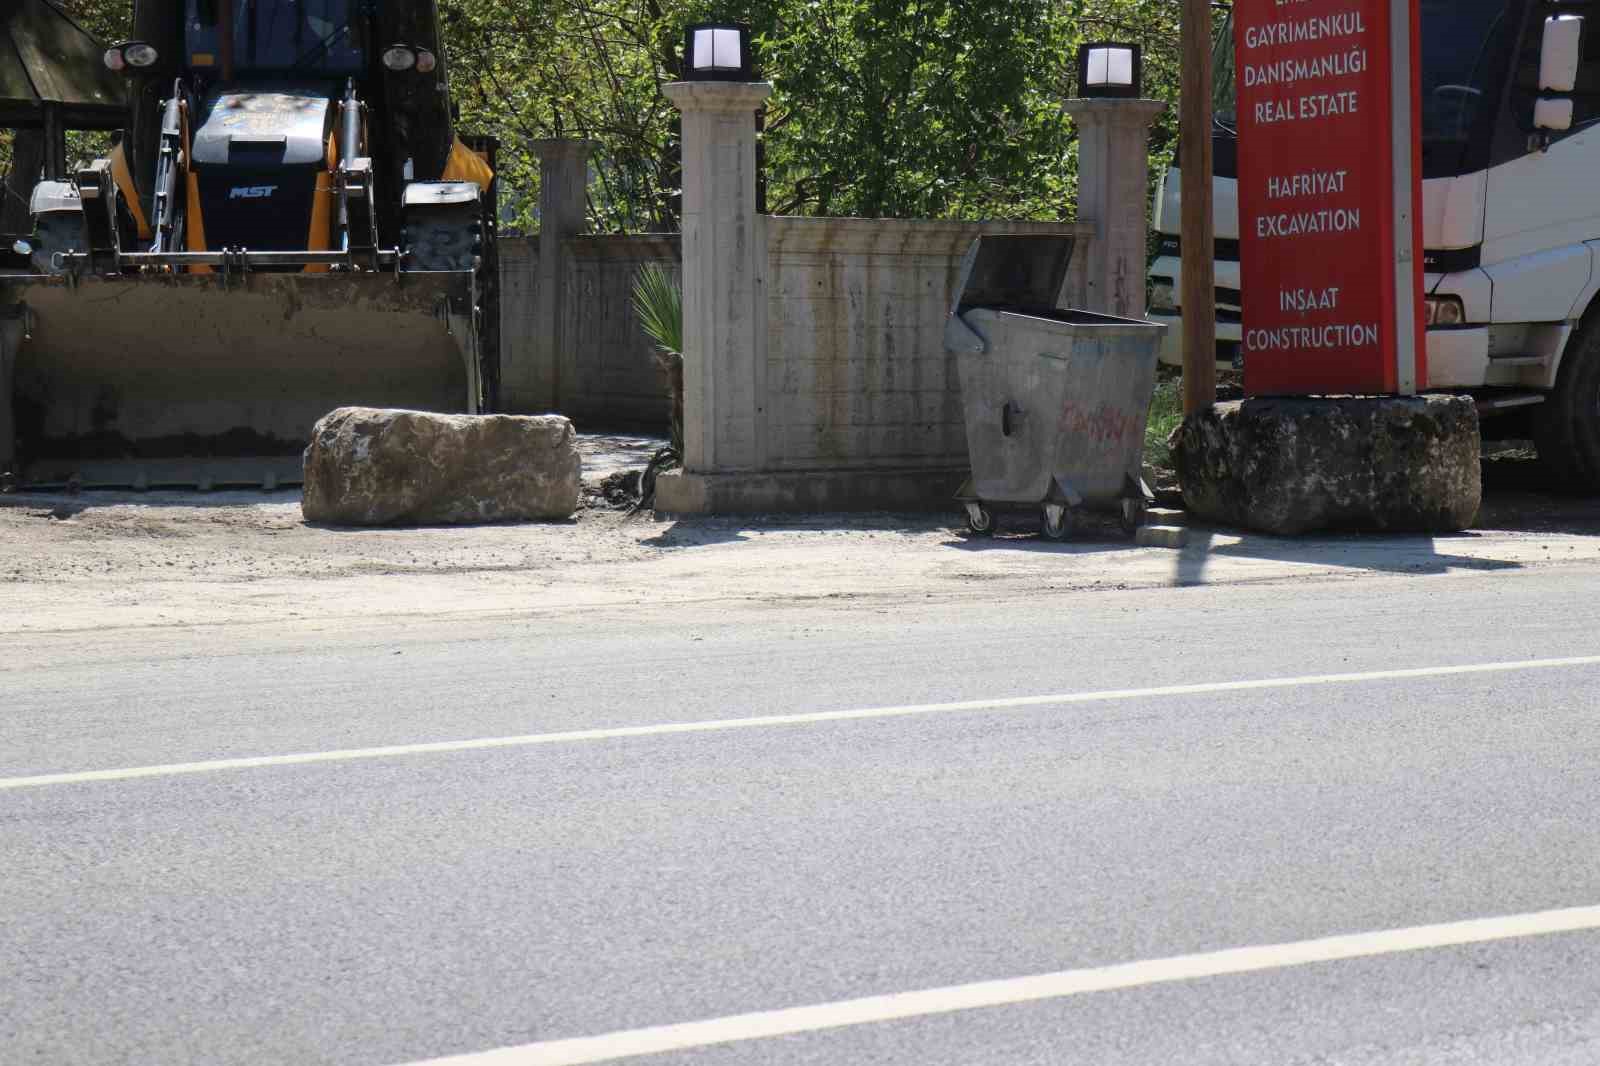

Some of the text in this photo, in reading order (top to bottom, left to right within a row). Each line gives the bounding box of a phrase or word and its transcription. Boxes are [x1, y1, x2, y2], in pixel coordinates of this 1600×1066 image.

[1245, 11, 1366, 49] GAYRİMENKUL
[1255, 91, 1358, 124] REAL ESTATE
[229, 185, 279, 199] MST
[1268, 168, 1347, 199] HAFRİYAT
[1257, 208, 1361, 238] EXCAVATION
[1246, 323, 1378, 351] CONSTRUCTION
